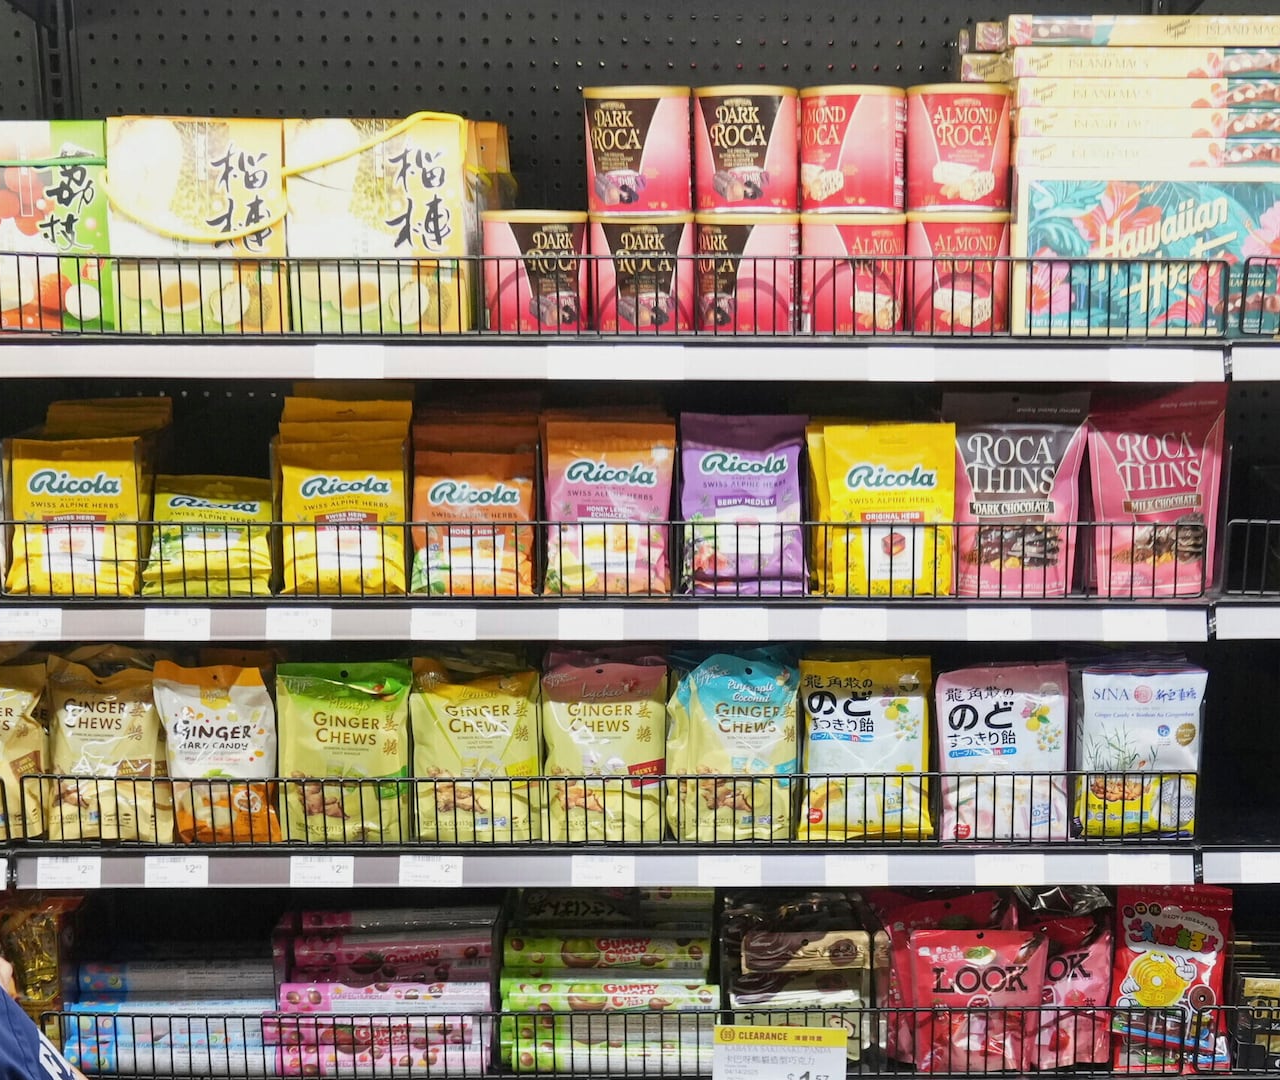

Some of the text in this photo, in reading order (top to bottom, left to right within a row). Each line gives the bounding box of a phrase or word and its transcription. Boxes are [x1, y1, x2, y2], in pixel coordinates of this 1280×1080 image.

[934, 105, 997, 125] ALMOND
[591, 128, 642, 150] ROCA
[710, 123, 764, 147] ROCA
[30, 470, 121, 496] Ricola
[969, 463, 1055, 495] THINS
[1120, 460, 1202, 495] THINS
[29, 501, 120, 511] SWISS ALPINE HERBS
[168, 497, 258, 515] Ricola
[303, 500, 389, 511] SWISS ALPINE HERBS
[717, 497, 775, 507] BERRY MEDLEY
[849, 497, 935, 506] SWISS ALPINE HERBS
[974, 501, 1051, 516] DARK CHOCOLATE
[1130, 496, 1198, 512] MILK CHOCOLATE
[865, 513, 921, 521] ORIGINAL HERB
[806, 674, 873, 689] 龍角散の
[946, 686, 1014, 702] 龍角散の
[1092, 688, 1129, 702] SINA
[63, 699, 127, 716] GINGER
[808, 690, 873, 717] のど
[64, 714, 123, 732] CHEWS
[948, 704, 1014, 731] のど
[179, 739, 249, 752] HARD CANDY
[947, 730, 1017, 748] すっきり飴
[933, 965, 1029, 993] LOOK
[739, 1031, 788, 1041] CLEARANCE
